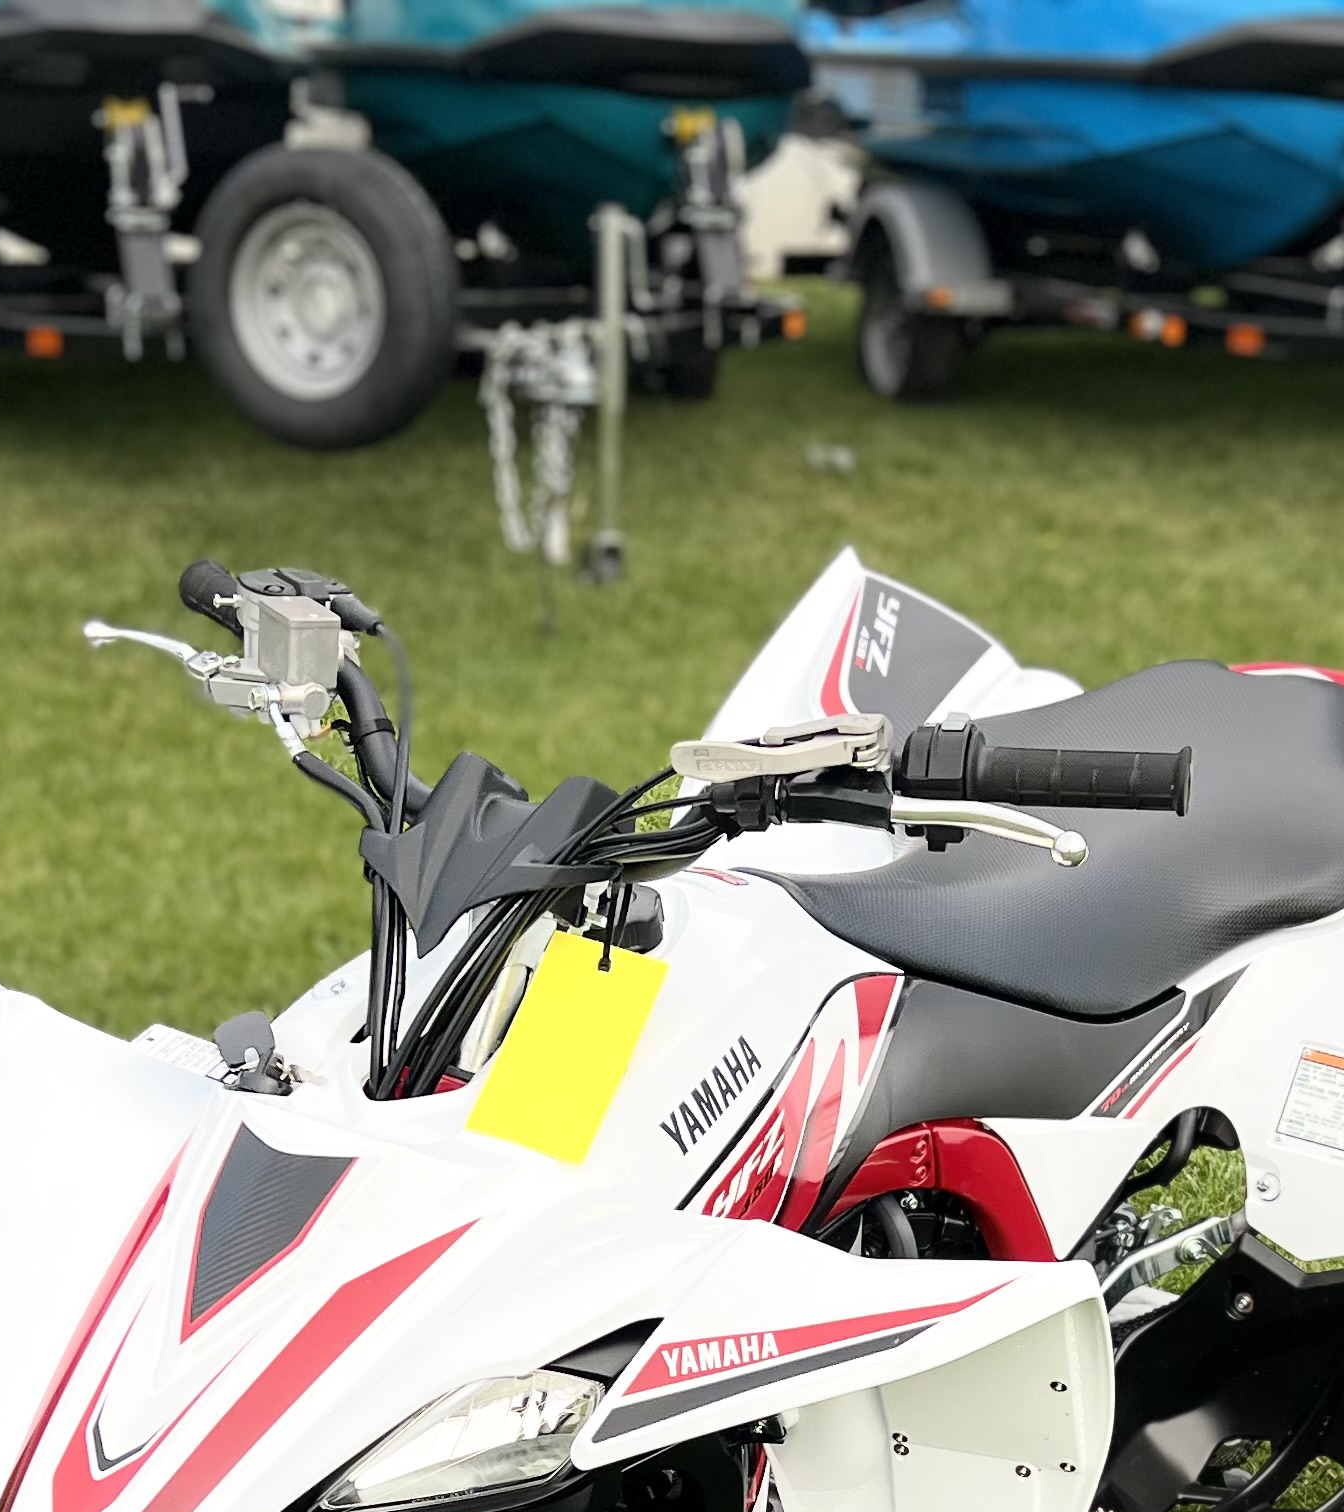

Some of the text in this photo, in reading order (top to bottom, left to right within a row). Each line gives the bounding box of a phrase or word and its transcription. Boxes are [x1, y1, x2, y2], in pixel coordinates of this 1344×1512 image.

[865, 592, 900, 677] YFZ
[659, 1034, 762, 1156] YAMAHA
[661, 1332, 780, 1378] YAMAHA
